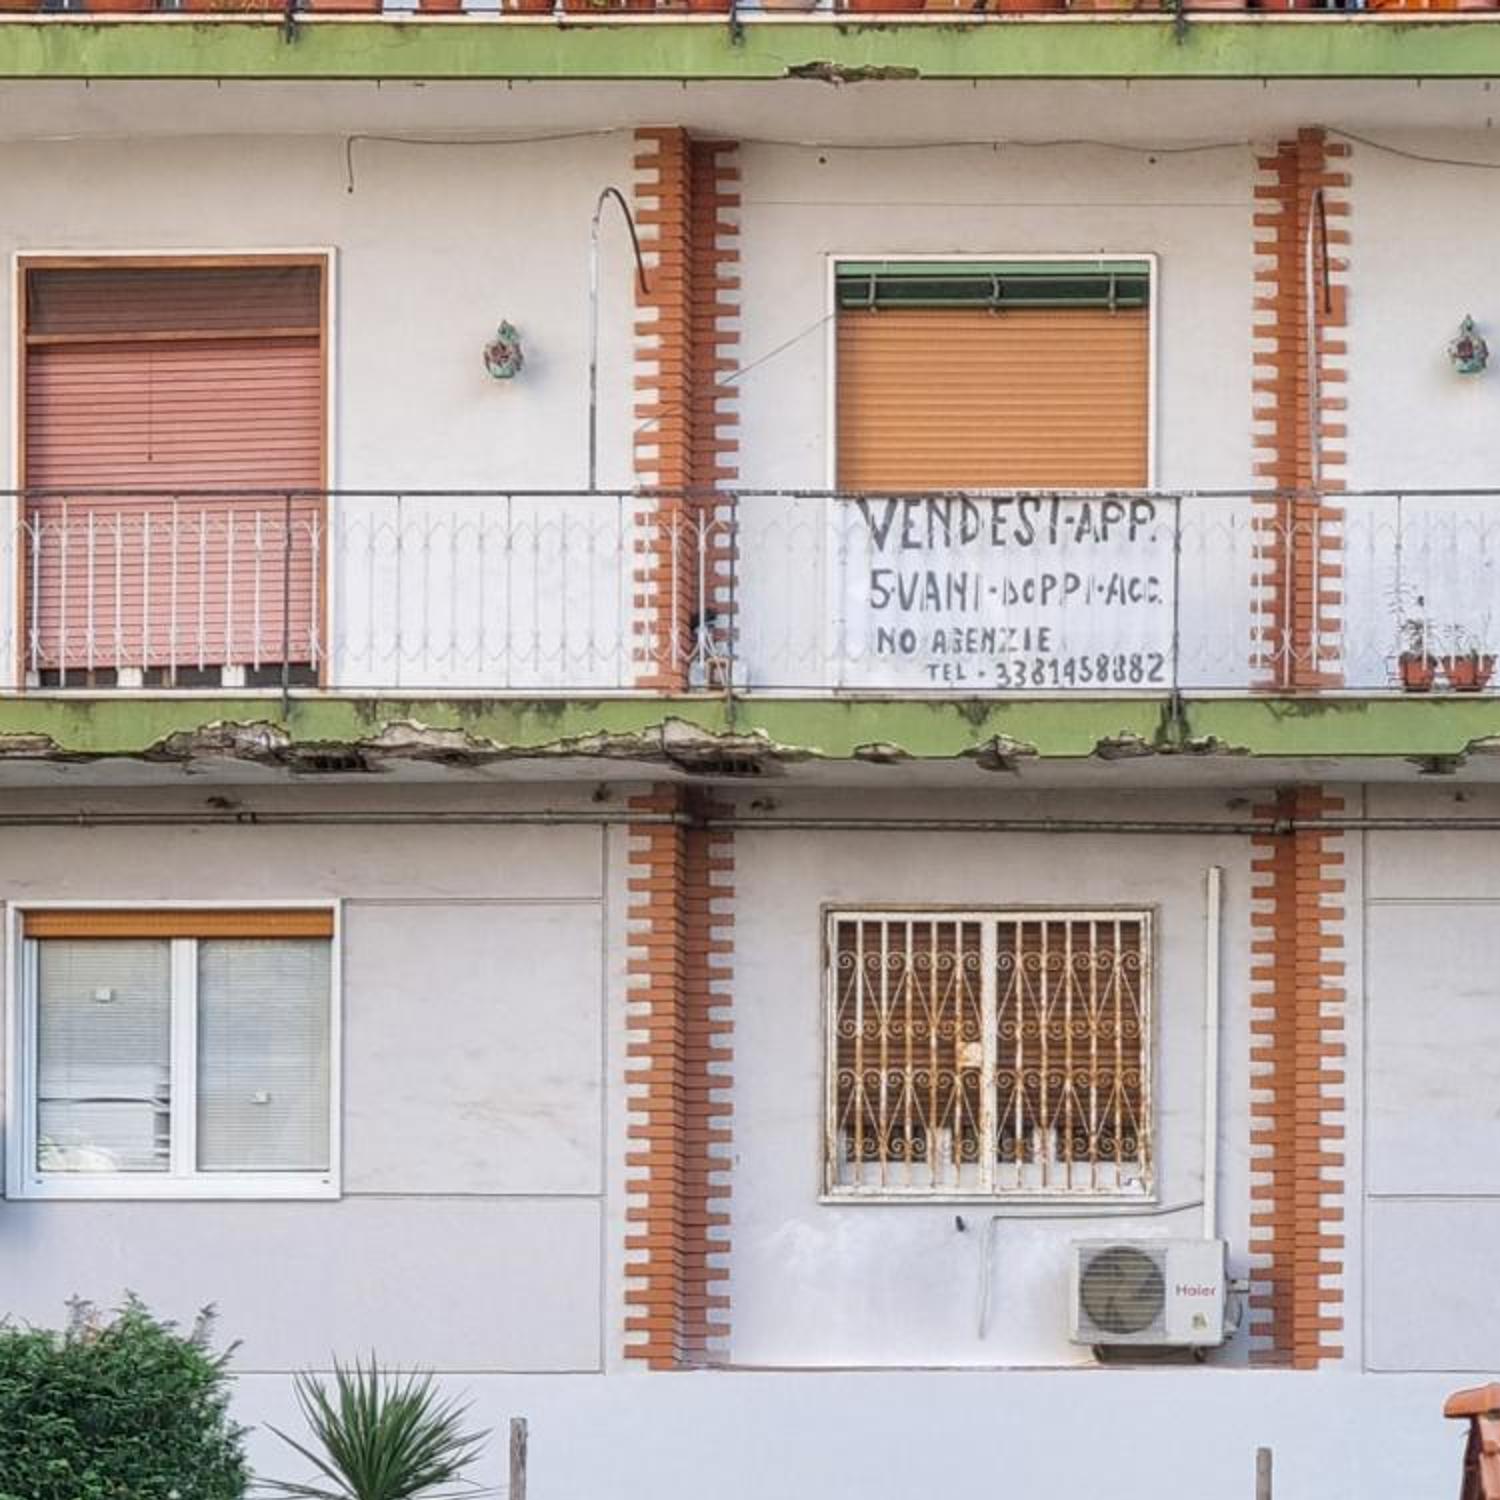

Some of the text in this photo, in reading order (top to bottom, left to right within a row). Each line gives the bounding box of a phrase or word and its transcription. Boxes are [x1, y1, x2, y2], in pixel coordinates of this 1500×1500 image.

[877, 626, 1052, 655] NO AGENZIE
[1175, 1284, 1217, 1297] Haier
